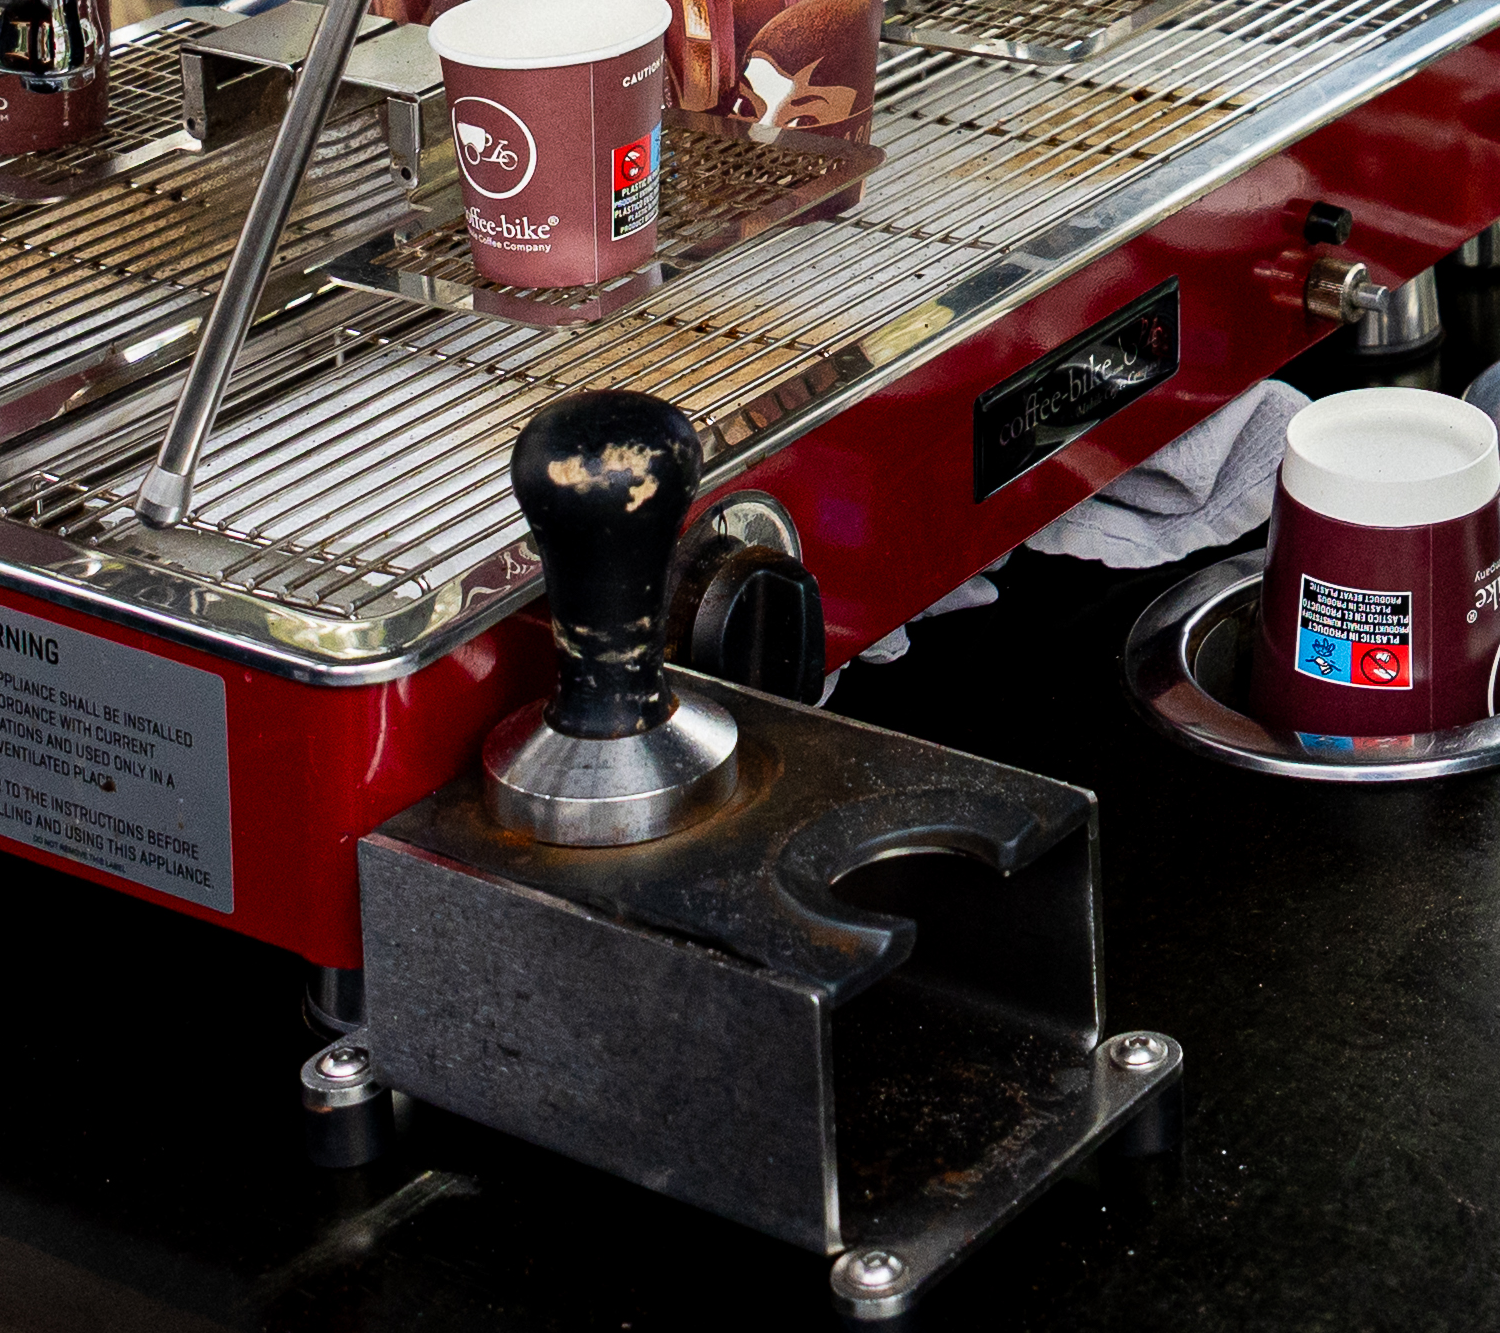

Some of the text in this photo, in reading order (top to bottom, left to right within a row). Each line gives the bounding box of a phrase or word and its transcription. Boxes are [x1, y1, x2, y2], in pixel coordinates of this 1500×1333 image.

[622, 56, 661, 88] CAUTION
[503, 241, 551, 253] Company
[1309, 582, 1402, 605] PRODUCT BEVAT PLASTIC
[1317, 594, 1347, 608] PRODUS
[1302, 598, 1409, 626] PLÁSTICO EN EL PRODUCTO
[1358, 603, 1391, 613] PLASTIC
[1307, 621, 1400, 644] PLASTIC IN PRODUCT
[1375, 625, 1409, 634] PRODUKT
[60, 691, 100, 718] SHALL
[103, 705, 119, 724] BE
[124, 712, 192, 748] INSTALLED
[60, 715, 91, 737] WITH
[96, 726, 155, 758] CURRENT
[46, 734, 72, 754] AND
[76, 743, 110, 766] USED
[114, 755, 146, 778] ONLY
[150, 767, 162, 785] IN
[166, 773, 175, 789] A
[5, 780, 20, 798] TO
[23, 786, 47, 808] THE
[52, 796, 144, 841] INSTRUCTIONS
[148, 829, 198, 860] BEFORE
[36, 815, 61, 835] AND
[65, 826, 103, 850] USING
[107, 839, 136, 861] THIS
[140, 851, 214, 888] APPLIANCE.
